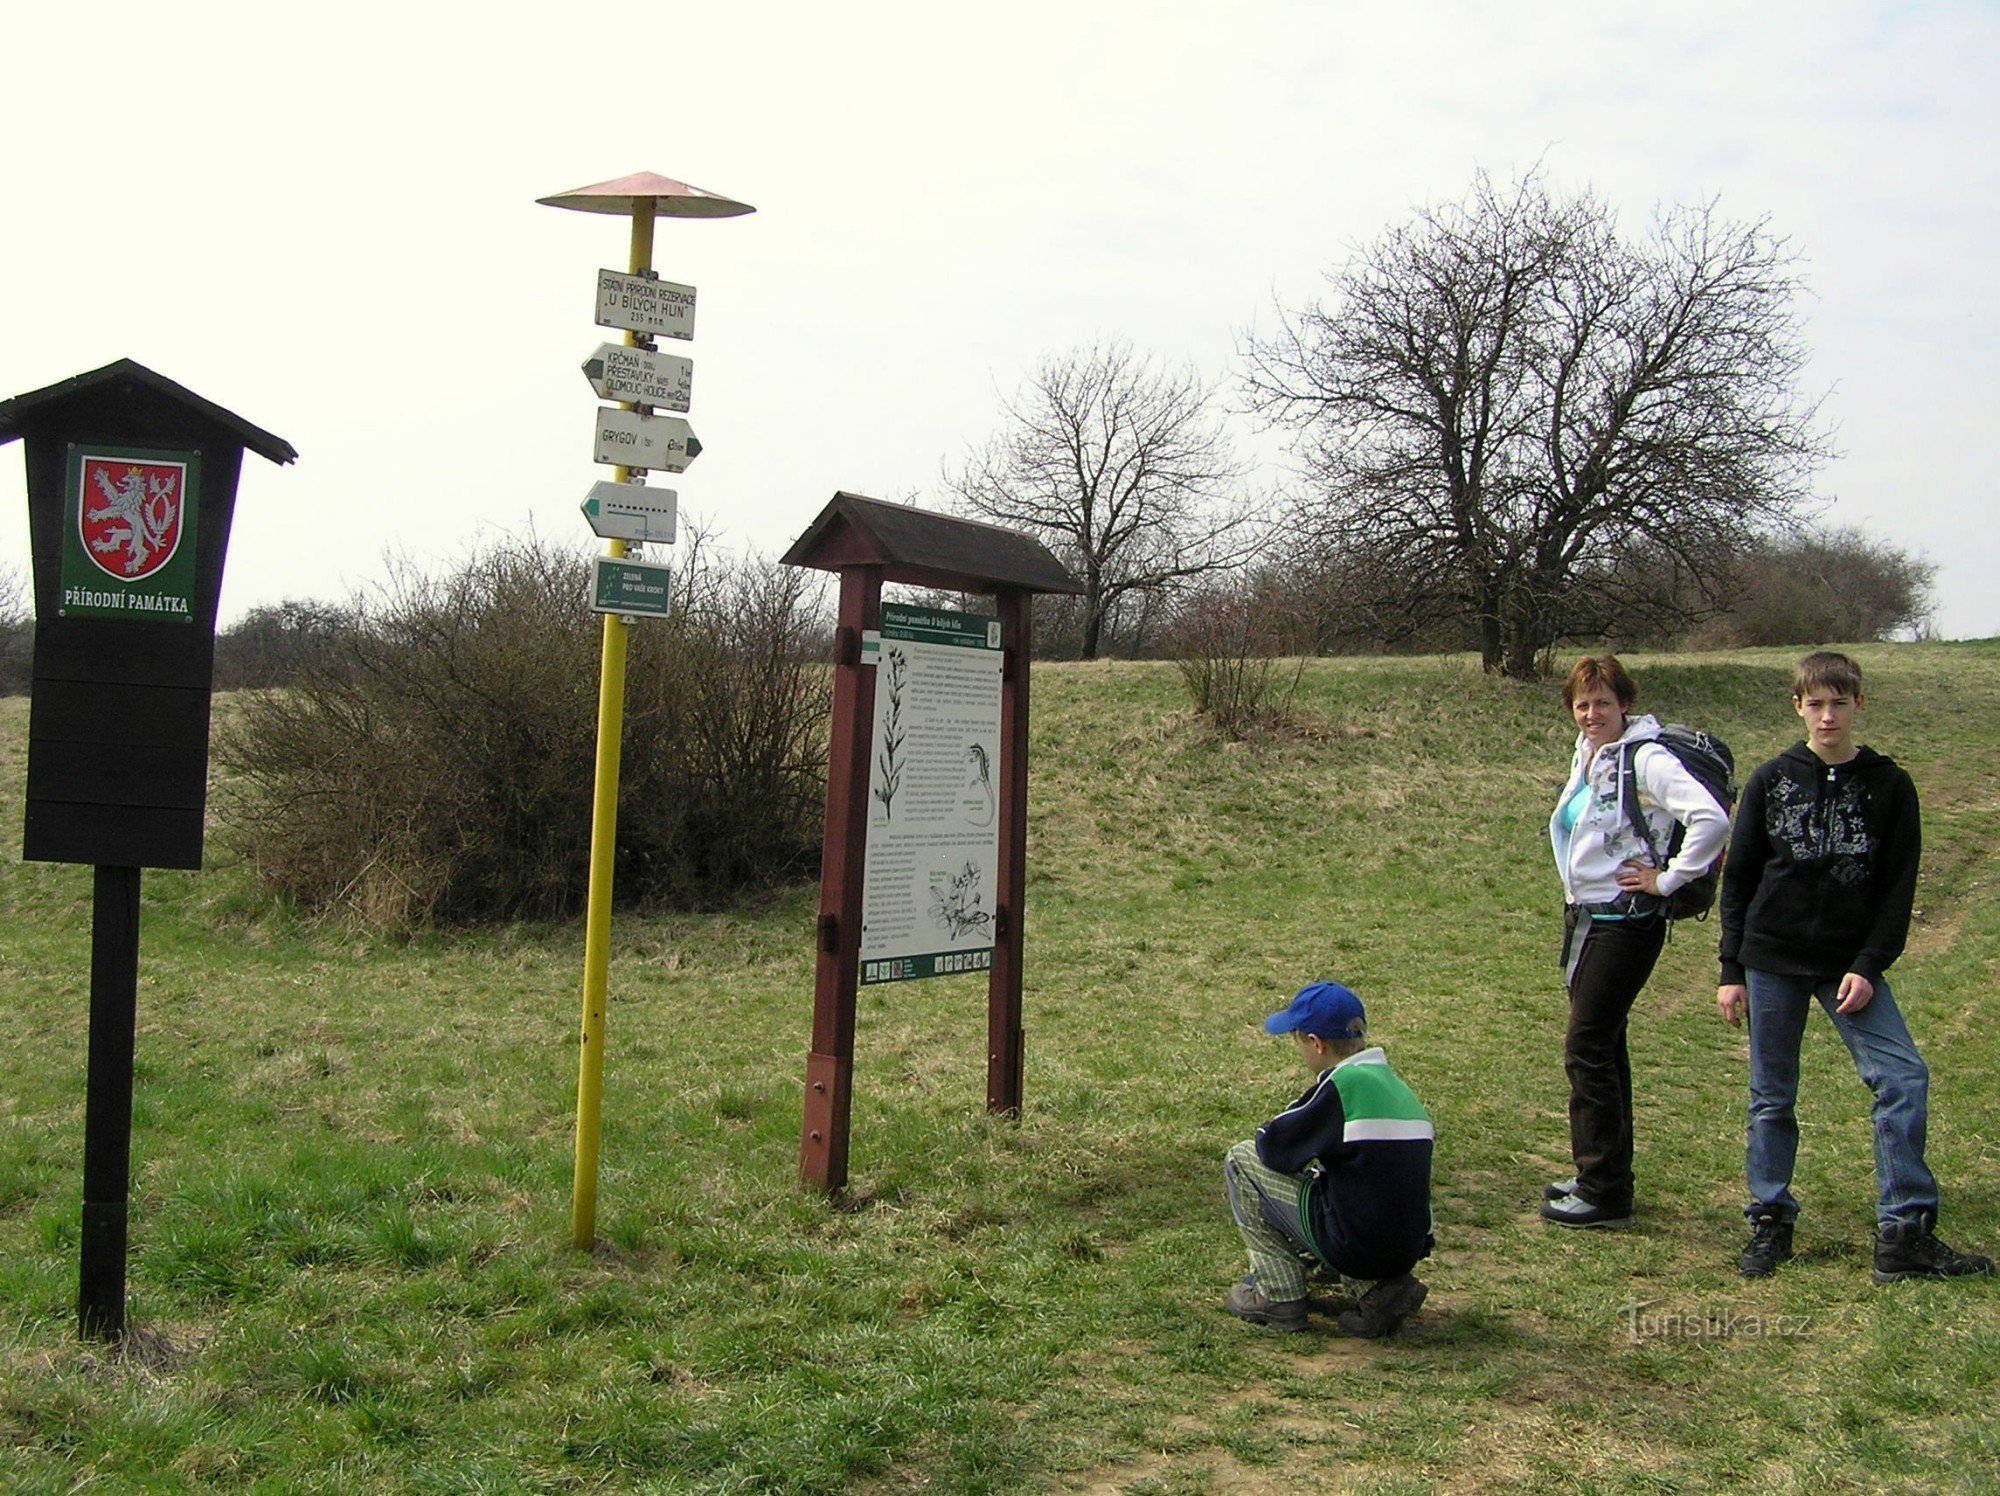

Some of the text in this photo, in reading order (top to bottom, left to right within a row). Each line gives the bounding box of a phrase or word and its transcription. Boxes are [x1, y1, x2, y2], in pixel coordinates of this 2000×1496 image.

[625, 279, 657, 299] PŘÍRODNÍ
[658, 289, 696, 306] REZERVACE
[621, 293, 657, 314] BÍLÝCH
[630, 311, 644, 322] 235
[607, 350, 640, 367] KRČMAŇ
[607, 363, 655, 383] PŘESTAVLKY
[606, 377, 642, 395] OLOMOUC
[643, 385, 666, 399] HOLICE
[602, 428, 638, 445] GRYGOV
[64, 585, 189, 613] PŘÍRODNÍ PAMÁTKA
